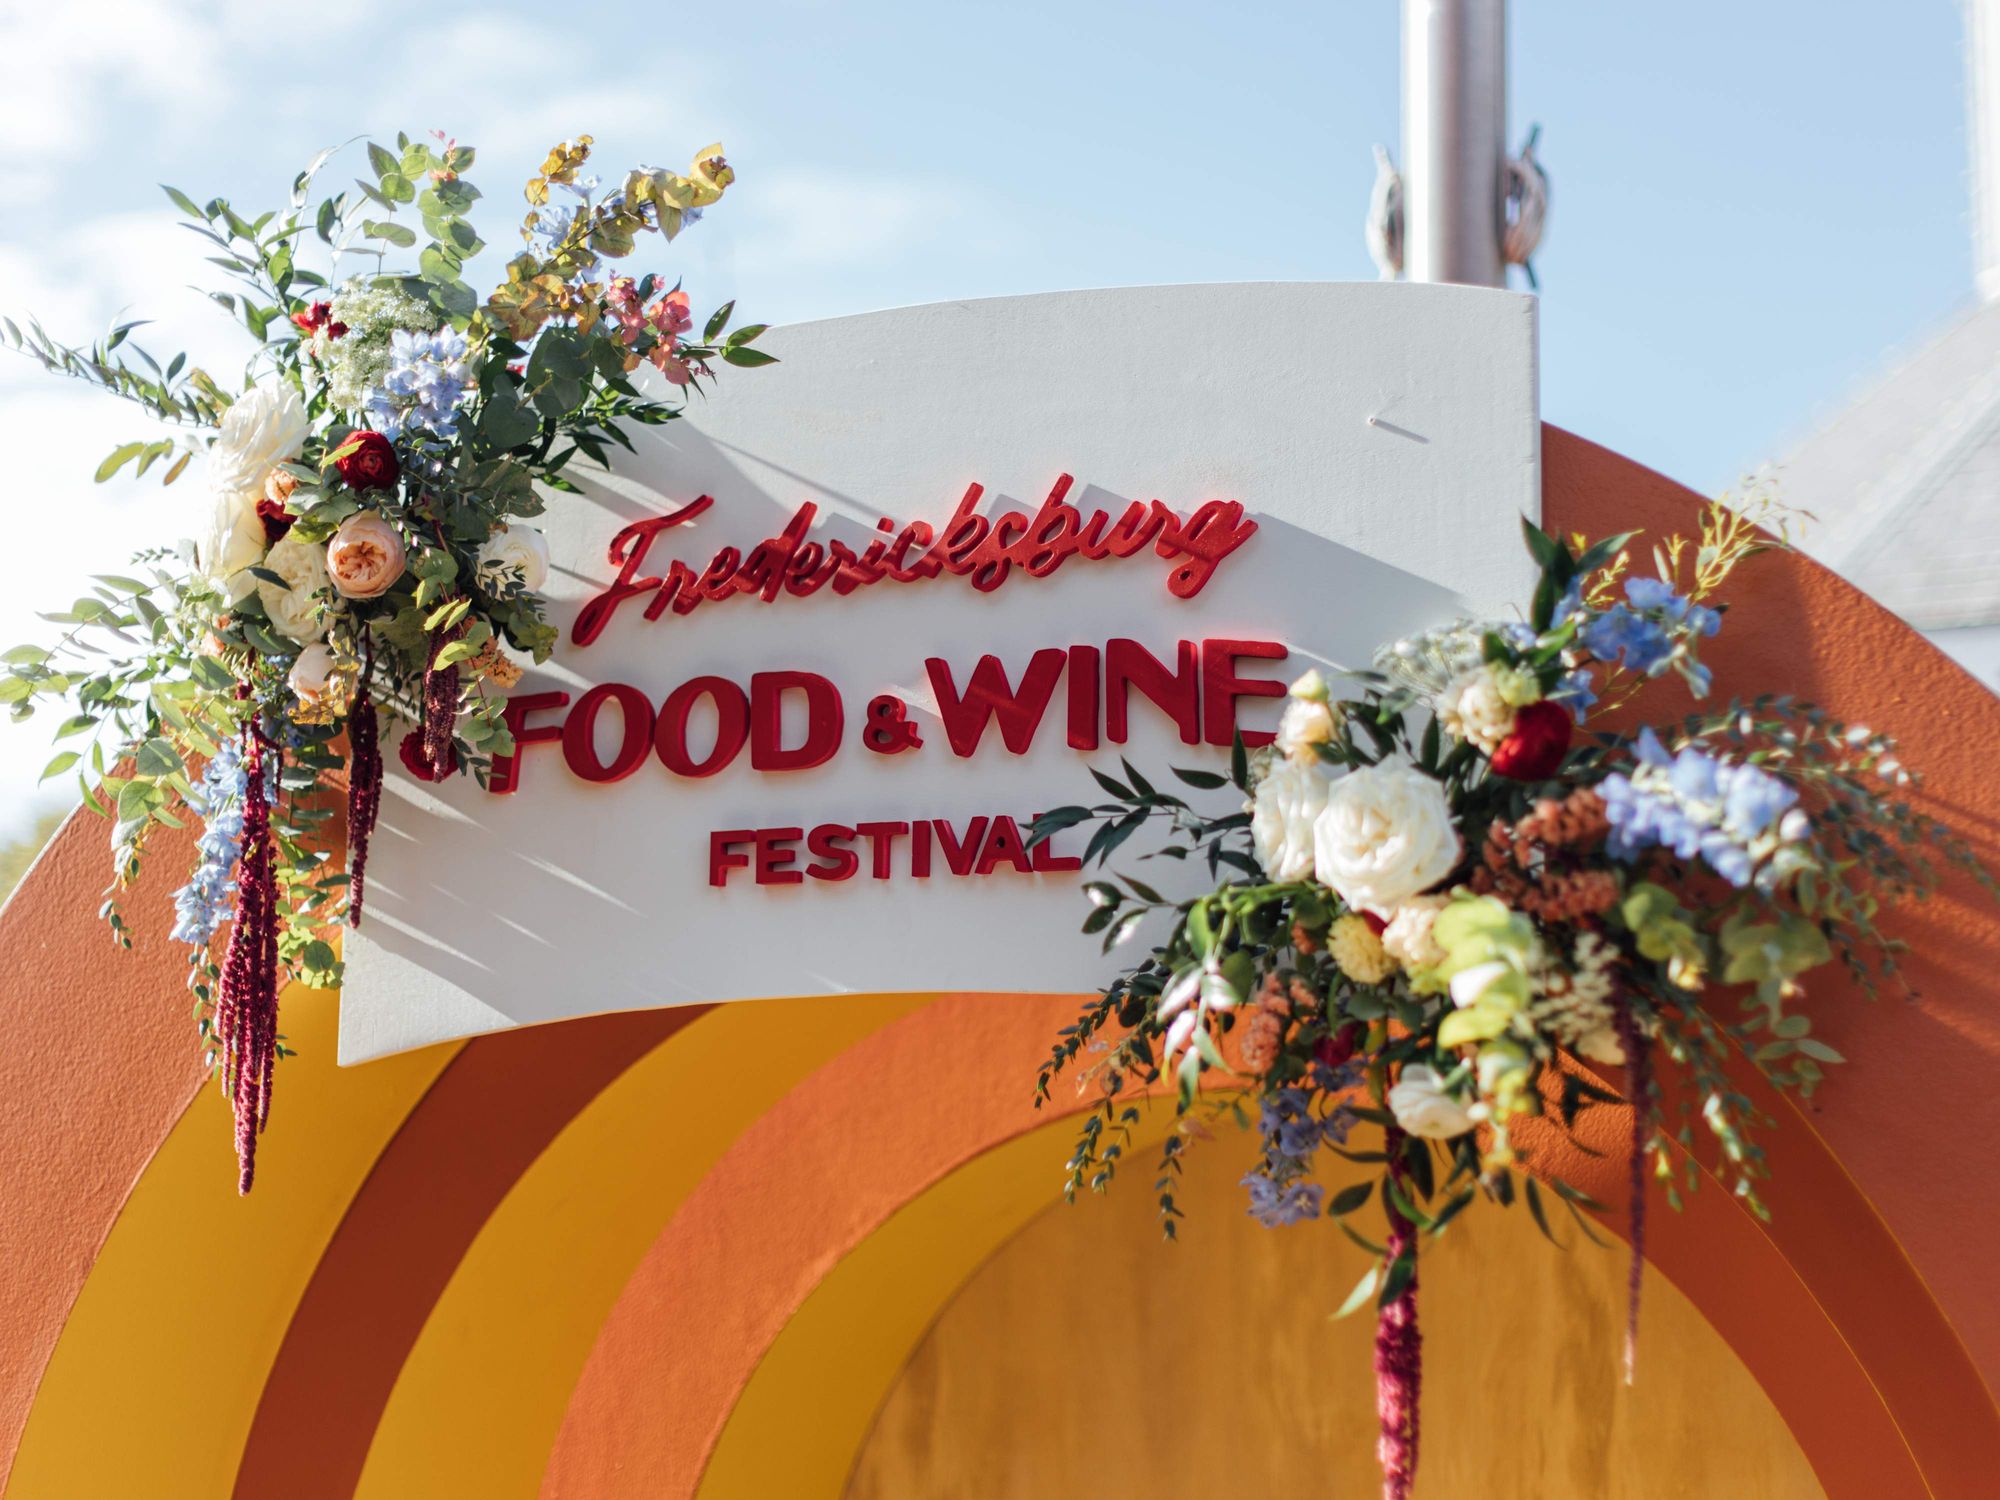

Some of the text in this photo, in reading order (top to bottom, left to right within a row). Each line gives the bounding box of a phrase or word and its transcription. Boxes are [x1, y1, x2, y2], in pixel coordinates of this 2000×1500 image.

[572, 473, 1259, 648] Fredericksburg
[489, 637, 1288, 796] FOOD & WINE
[709, 813, 1082, 889] FESTIVAL
